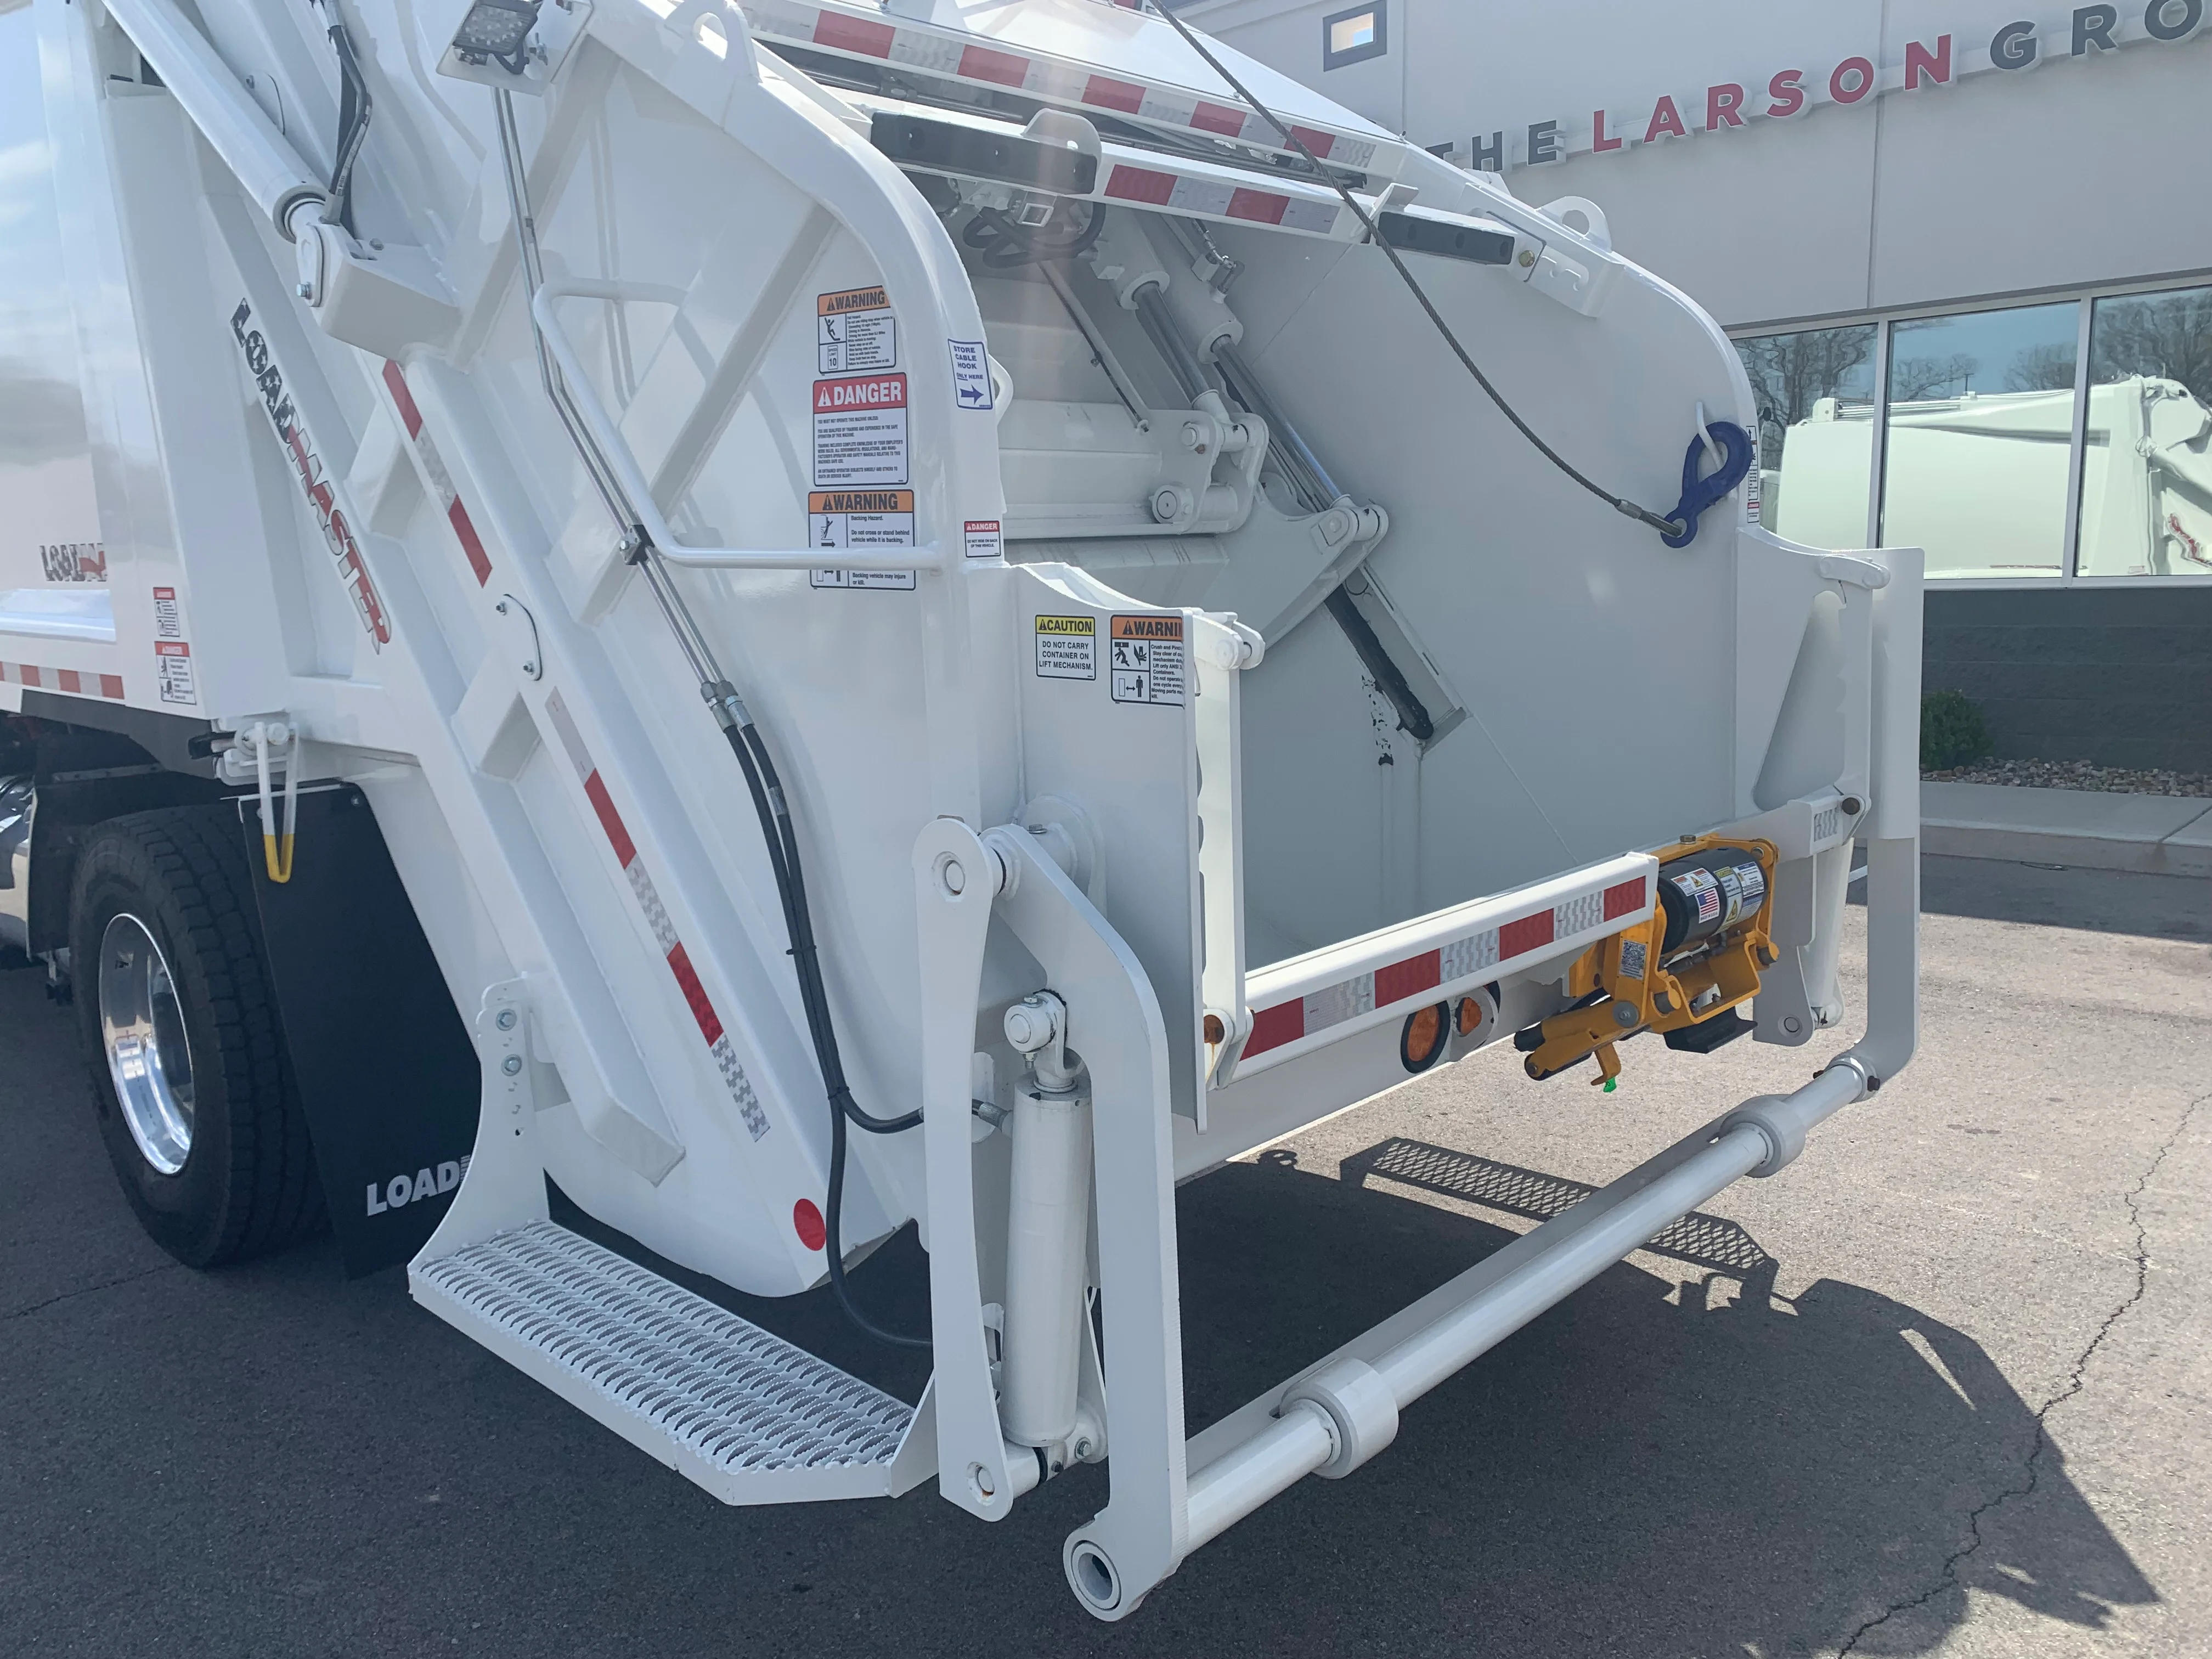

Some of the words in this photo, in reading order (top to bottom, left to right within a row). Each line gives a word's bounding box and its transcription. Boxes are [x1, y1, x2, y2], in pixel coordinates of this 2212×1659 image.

[1593, 33, 1951, 154] LARSON
[1990, 0, 2203, 70] GRO
[836, 290, 885, 310] WARNING
[829, 358, 837, 366] 10
[834, 382, 901, 405] DANGER
[834, 493, 898, 510] WARNING
[1047, 619, 1092, 632] CAUTION
[1042, 651, 1077, 659] CONTAINER
[1053, 662, 1093, 670] MECHANISM.
